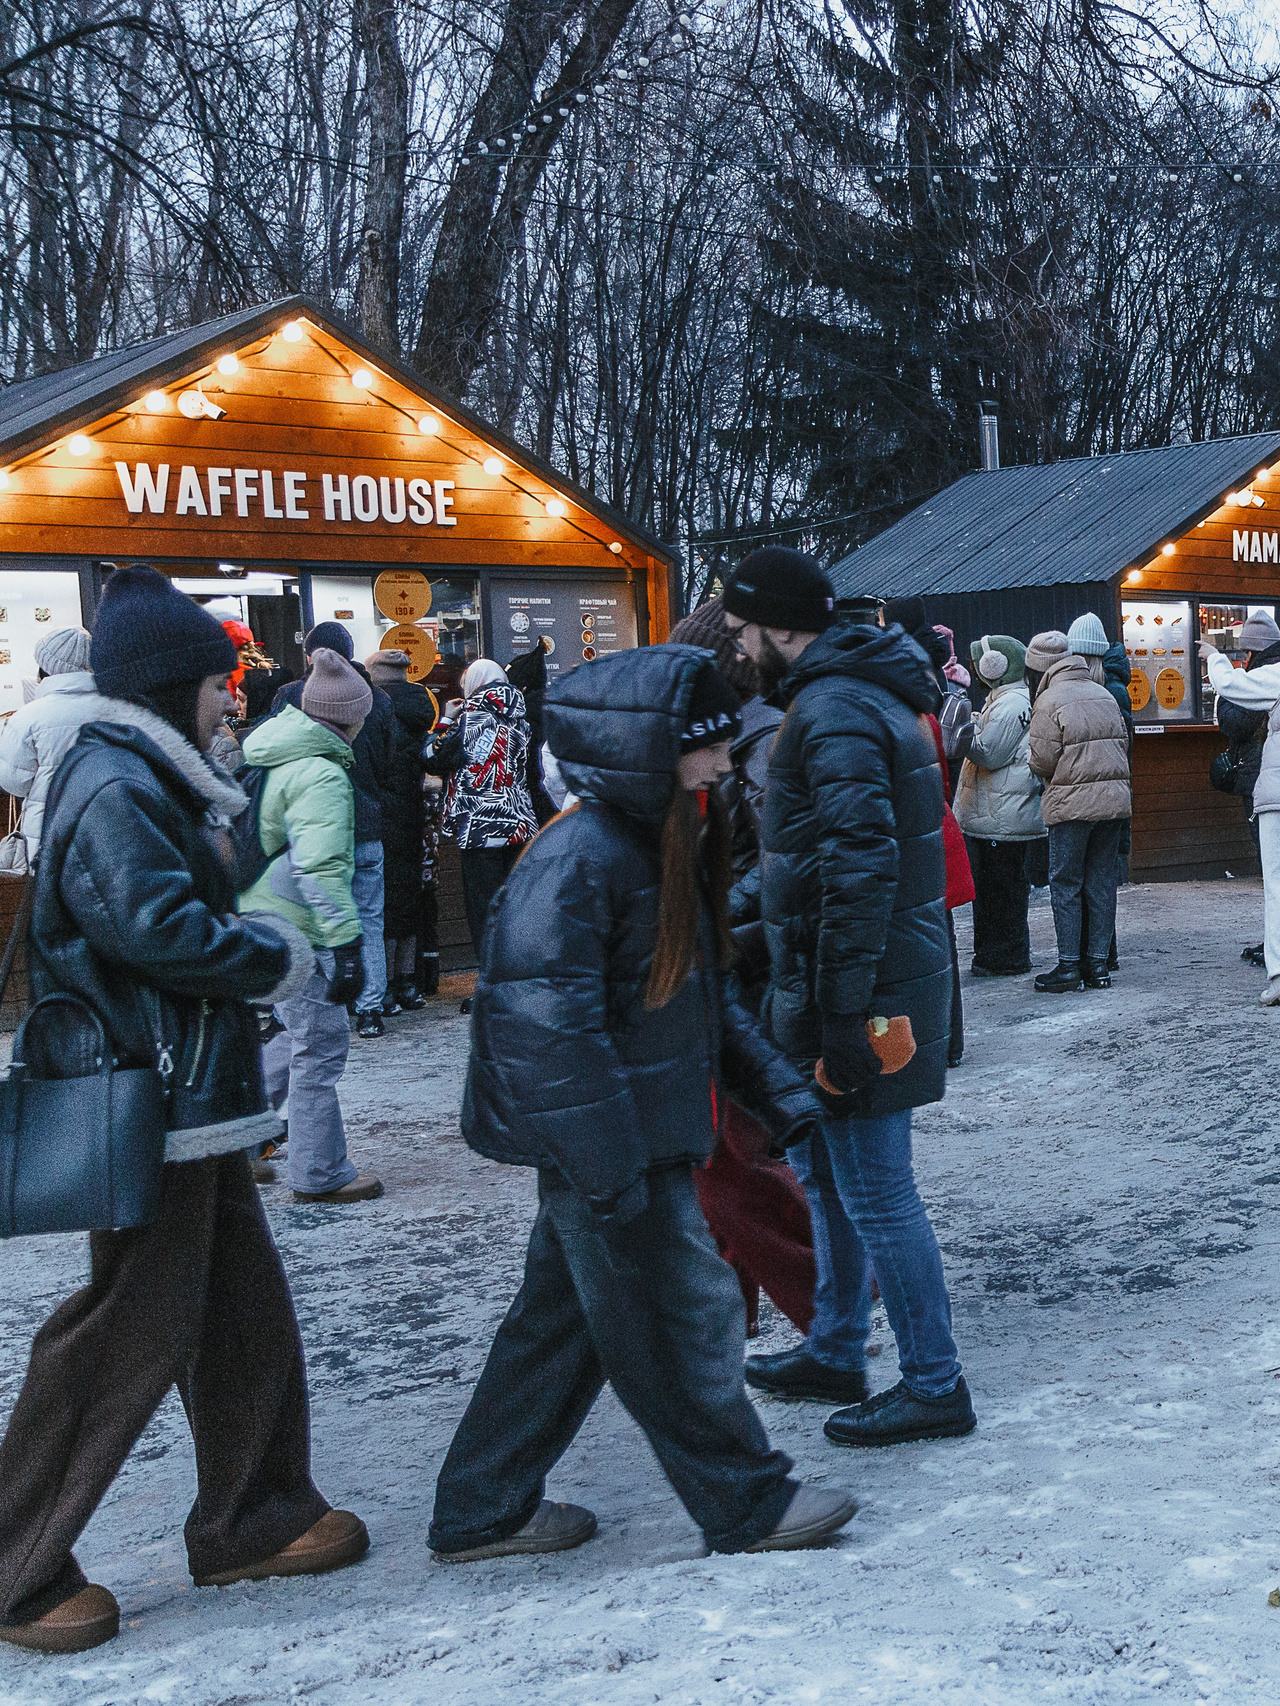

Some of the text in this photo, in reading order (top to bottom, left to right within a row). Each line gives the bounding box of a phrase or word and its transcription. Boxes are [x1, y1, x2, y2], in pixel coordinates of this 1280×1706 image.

[114, 461, 458, 526] WAFFLE HOUSE
[395, 607, 408, 616] 130
